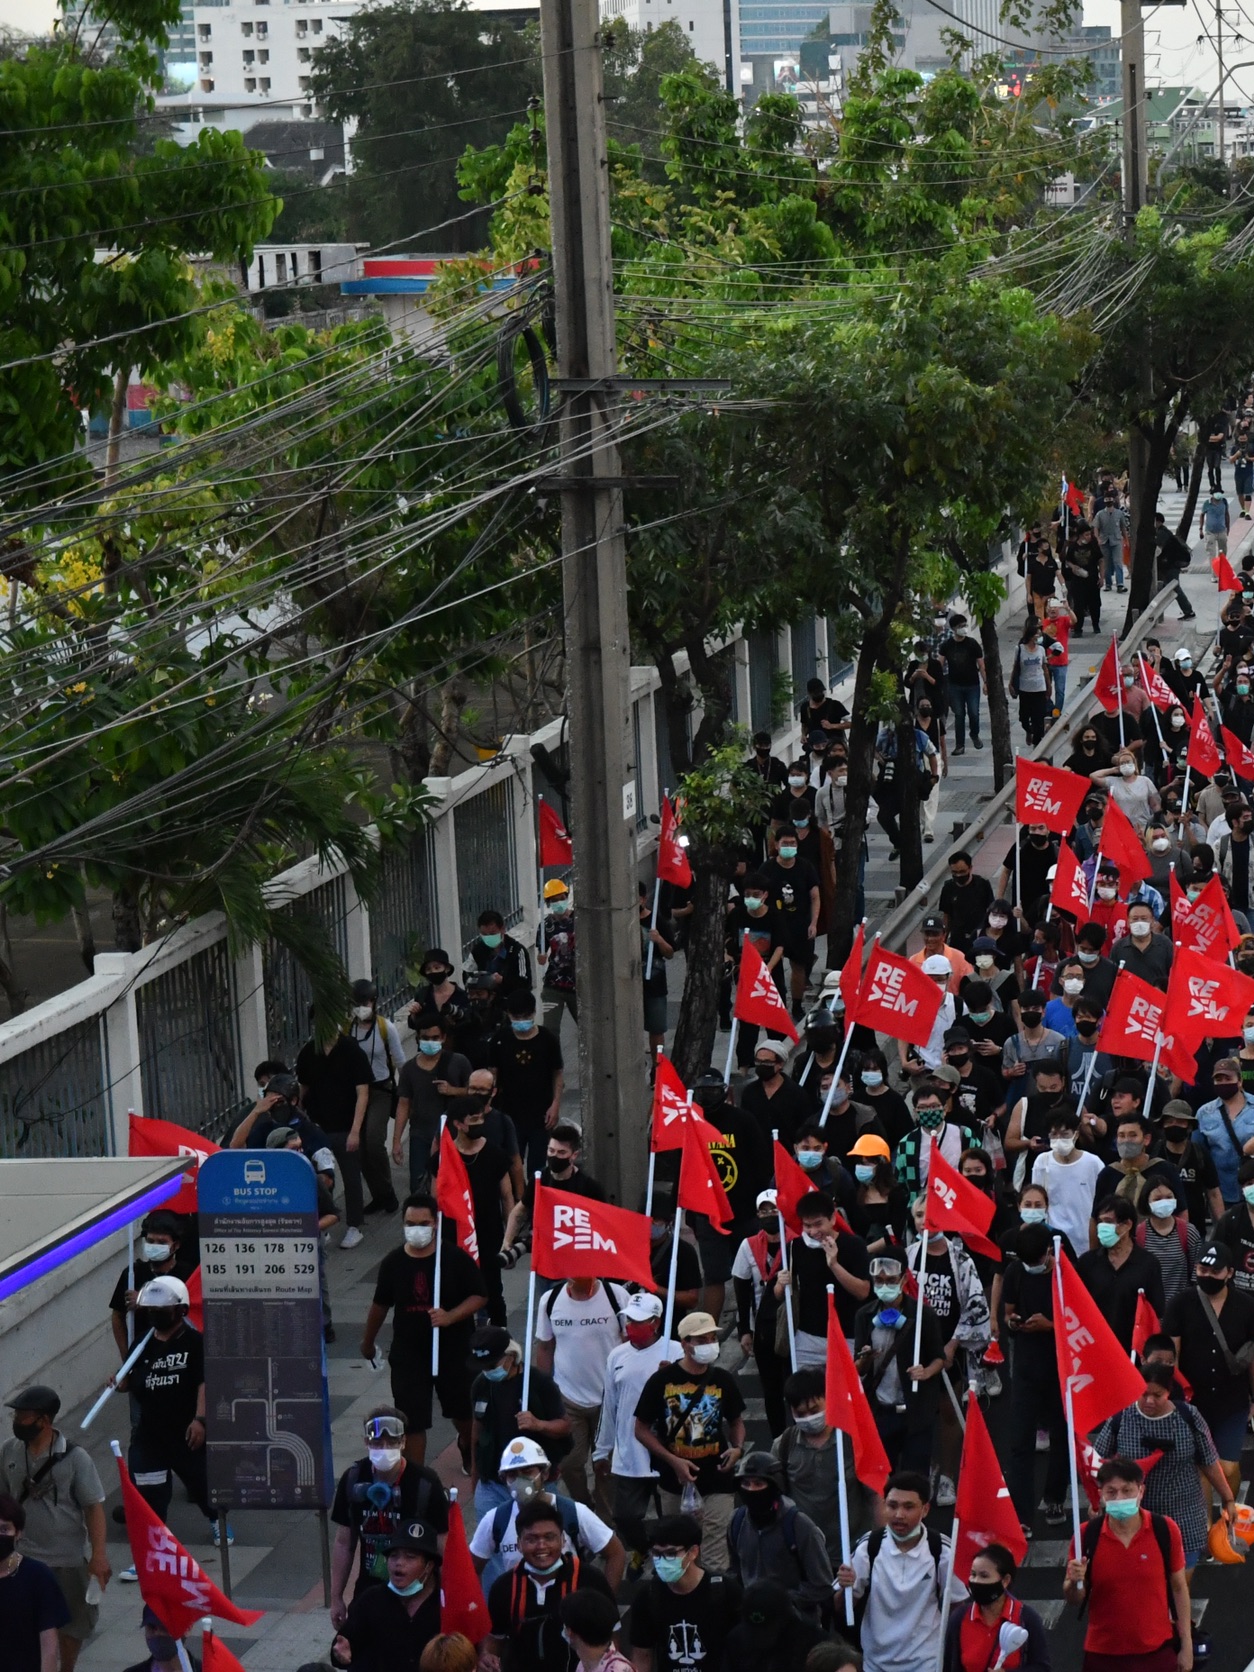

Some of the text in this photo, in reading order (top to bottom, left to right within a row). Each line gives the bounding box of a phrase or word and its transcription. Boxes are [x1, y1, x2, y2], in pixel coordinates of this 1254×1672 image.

[1027, 778, 1053, 800] RE
[875, 962, 906, 989] RE
[1187, 977, 1220, 997] RE
[1130, 996, 1162, 1024] RE
[233, 1187, 278, 1196] BUS STOP
[554, 1205, 590, 1228] RE
[205, 1243, 314, 1254] 126 136 178 179
[206, 1264, 315, 1275] 185 191 206 529
[297, 1286, 312, 1294] Map
[580, 1317, 609, 1326] CRACY
